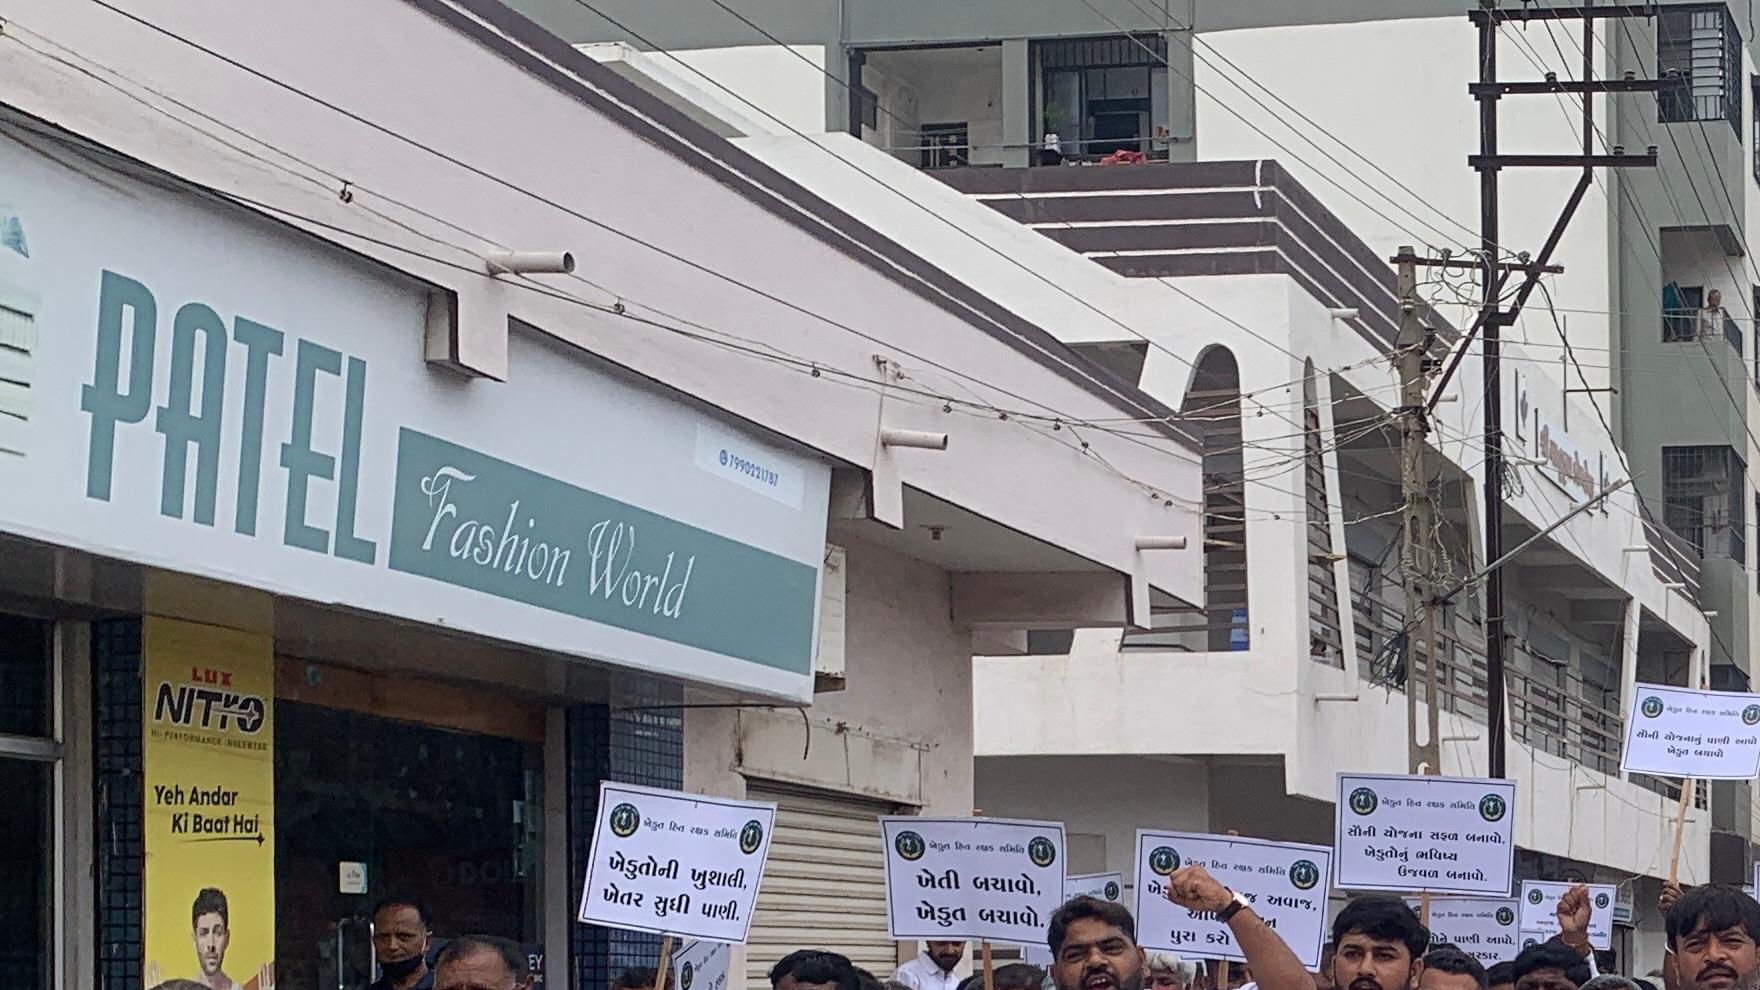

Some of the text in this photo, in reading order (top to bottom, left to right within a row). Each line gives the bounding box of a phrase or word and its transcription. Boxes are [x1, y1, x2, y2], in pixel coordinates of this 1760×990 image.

[81, 268, 377, 565] PATEL
[420, 465, 696, 620] Fashion World
[191, 666, 233, 687] LUX
[154, 785, 239, 807] Yeh Andar
[172, 812, 259, 834] Ki Baat Hai
[609, 851, 679, 880] ખેડુતોની
[916, 868, 960, 890] ખેતી
[603, 883, 740, 921] ખેતર સુધી પાણી.
[915, 900, 1045, 928] ખેડુત બચાવો.
[1170, 930, 1230, 946] પુરા કરો
